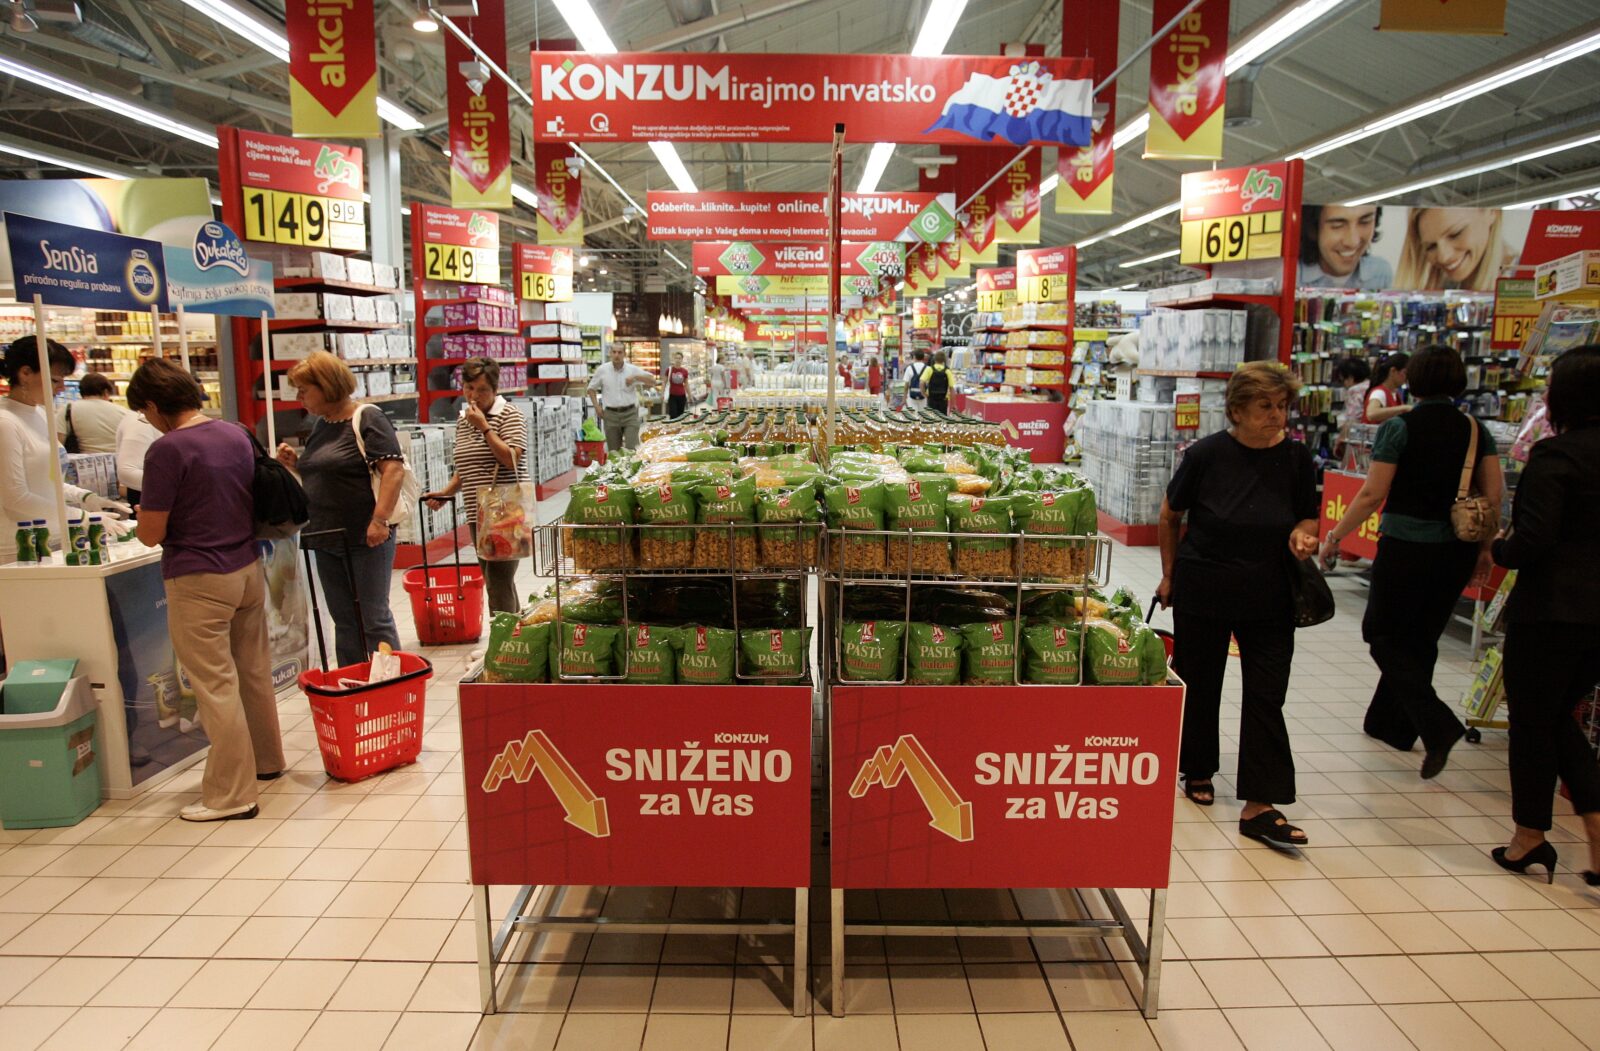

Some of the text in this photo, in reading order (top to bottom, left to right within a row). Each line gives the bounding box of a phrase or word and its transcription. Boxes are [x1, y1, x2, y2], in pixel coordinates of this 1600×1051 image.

[308, 0, 354, 88] akcij
[1168, 12, 1210, 116] akcija
[823, 76, 936, 103] hrvatsko
[463, 95, 496, 174] akcija
[246, 140, 300, 155] Najpovoljnije
[546, 159, 571, 219] akcija
[1008, 161, 1031, 219] akcija
[777, 197, 920, 214] online.ONZUM.hr
[970, 195, 990, 243] akcija
[652, 226, 676, 235] Užitak
[678, 226, 703, 236] kupnje
[706, 227, 712, 235] iz
[715, 226, 738, 236] Vašeg
[739, 226, 760, 235] doma
[769, 227, 791, 236] novoj
[793, 227, 824, 235] Internet
[1546, 224, 1583, 233] KONZUM
[1206, 221, 1244, 257] 69
[40, 240, 98, 274] SenSia
[775, 246, 824, 261] vikend
[24, 274, 121, 293] prirodno regulira probavu
[1041, 278, 1049, 298] 8
[584, 506, 622, 519] PASTA
[650, 504, 688, 519] PASTA
[766, 508, 803, 520] PASTA
[838, 507, 873, 519] PASTA
[898, 504, 935, 518] PASTA
[1031, 509, 1066, 522] PASTA
[1326, 494, 1379, 538] akja
[960, 515, 997, 528] PASTA
[563, 648, 594, 664] PASTA
[846, 643, 883, 659] PASTA
[920, 646, 956, 659] PASTA
[1043, 651, 1077, 663] PASTA
[683, 654, 717, 668] PASTA
[758, 654, 795, 666] PASTA
[1103, 654, 1139, 668] PASTA
[714, 732, 769, 743] KONZUM
[1084, 736, 1139, 747] KONZUM
[605, 741, 792, 782] SNIŽENO
[974, 745, 1160, 785] SNIŽENO
[640, 788, 754, 816] za Vas
[1005, 792, 1119, 820] za Vas
